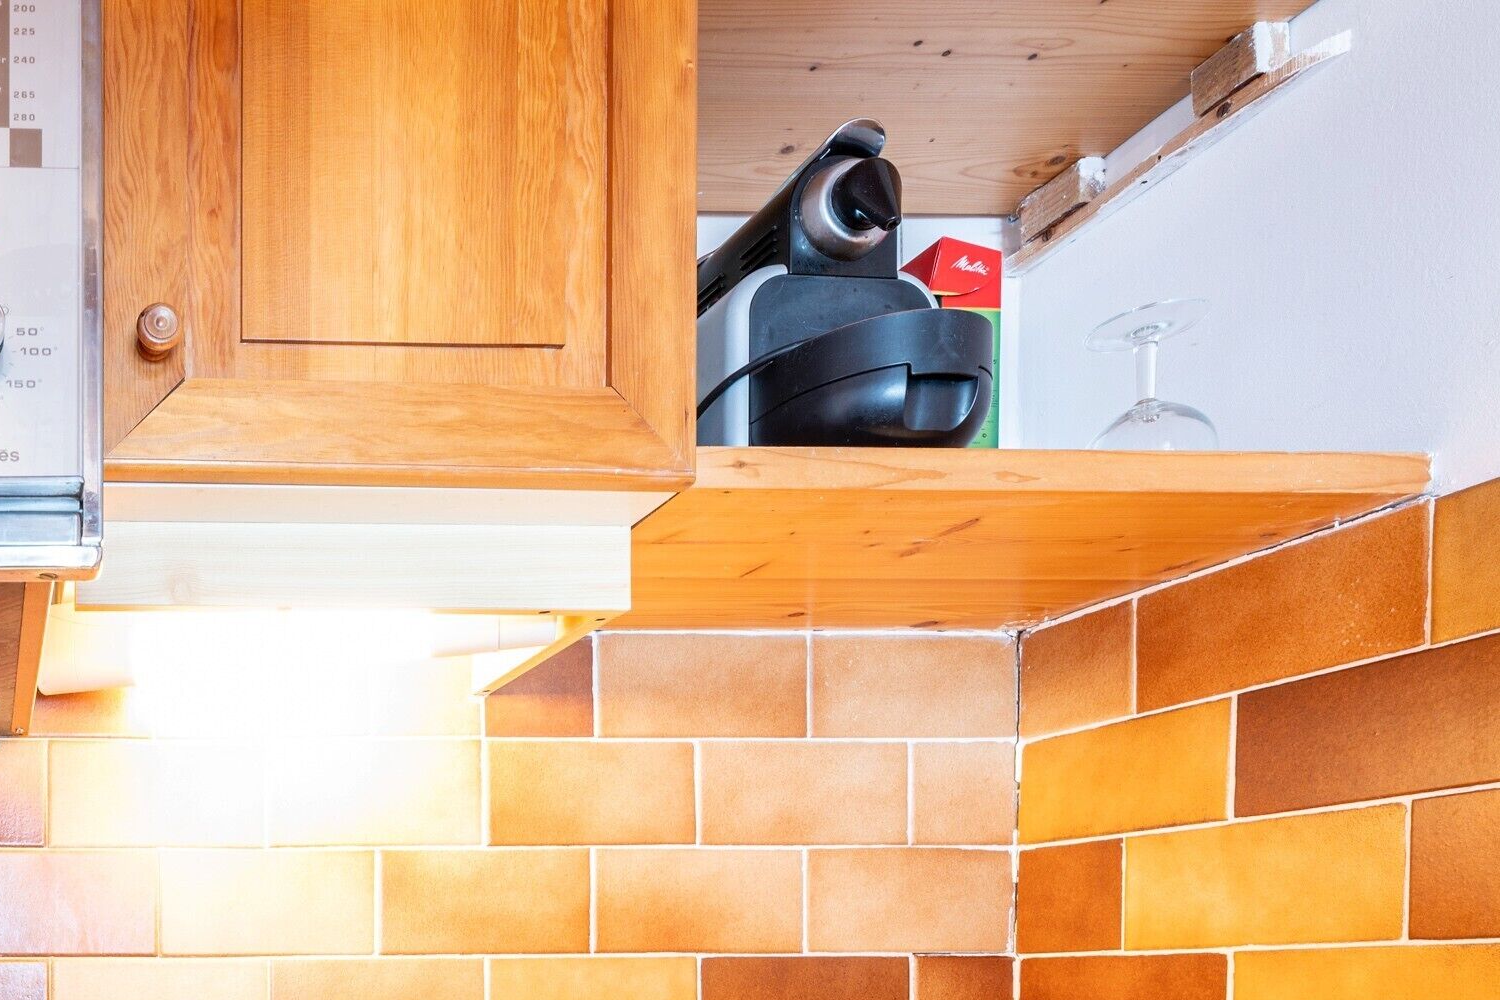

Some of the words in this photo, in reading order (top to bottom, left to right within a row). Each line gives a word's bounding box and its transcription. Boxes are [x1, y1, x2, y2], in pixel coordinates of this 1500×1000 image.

[13, 4, 36, 13] 200
[13, 27, 35, 36] 225
[13, 56, 35, 64] 240
[13, 91, 35, 99] 265
[13, 113, 35, 121] 280
